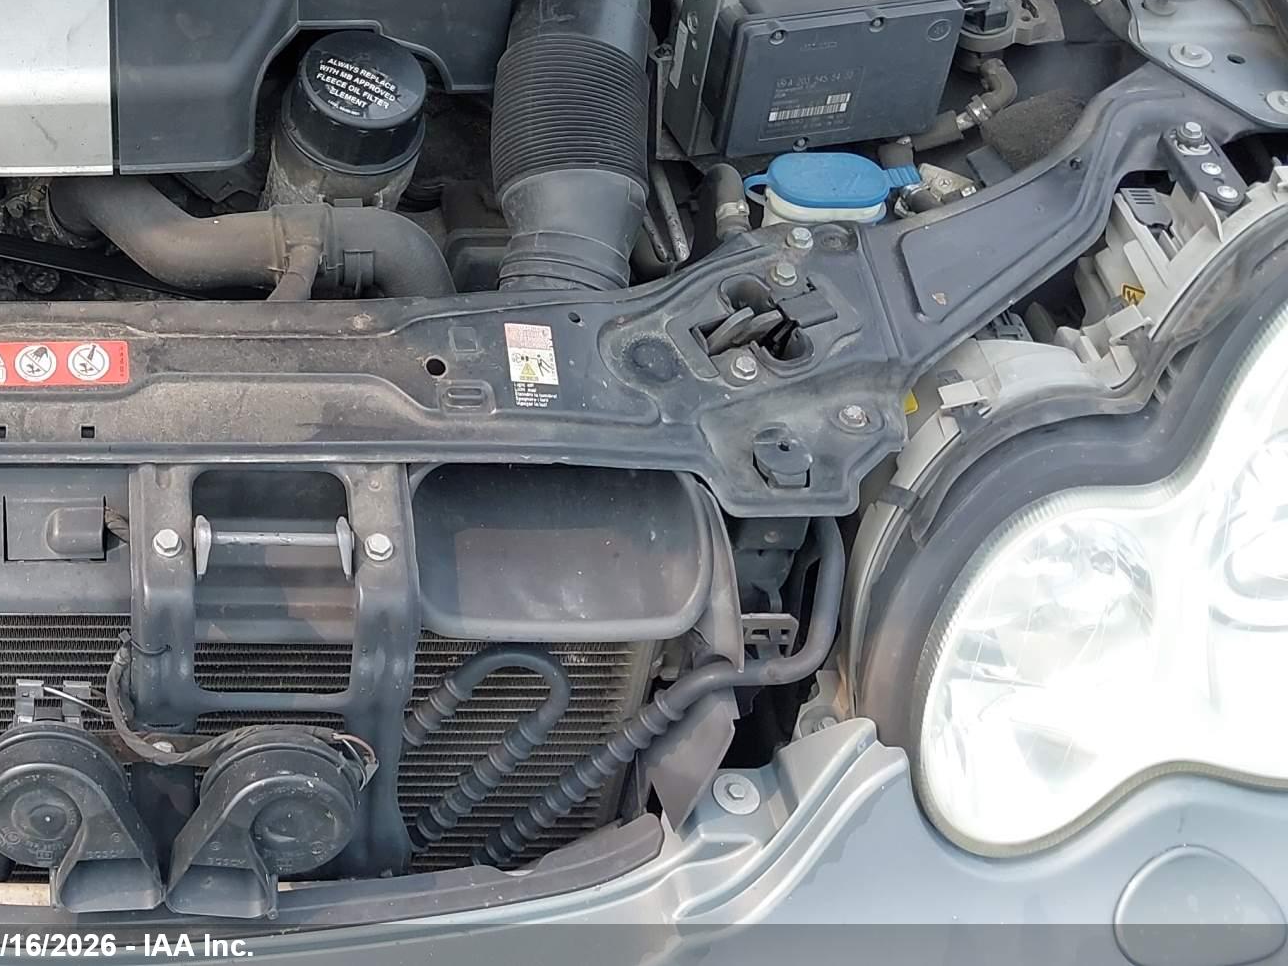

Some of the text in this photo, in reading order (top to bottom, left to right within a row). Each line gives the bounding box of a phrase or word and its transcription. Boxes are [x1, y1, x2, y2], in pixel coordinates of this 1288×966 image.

[316, 73, 348, 89] FLEECE
[348, 84, 361, 96] OIL
[362, 90, 390, 110] FILTER
[319, 64, 340, 76] WITH
[353, 75, 396, 102] APPROVED
[327, 58, 396, 92] ALWAYS REPLACE
[329, 86, 368, 109] ELEMENT
